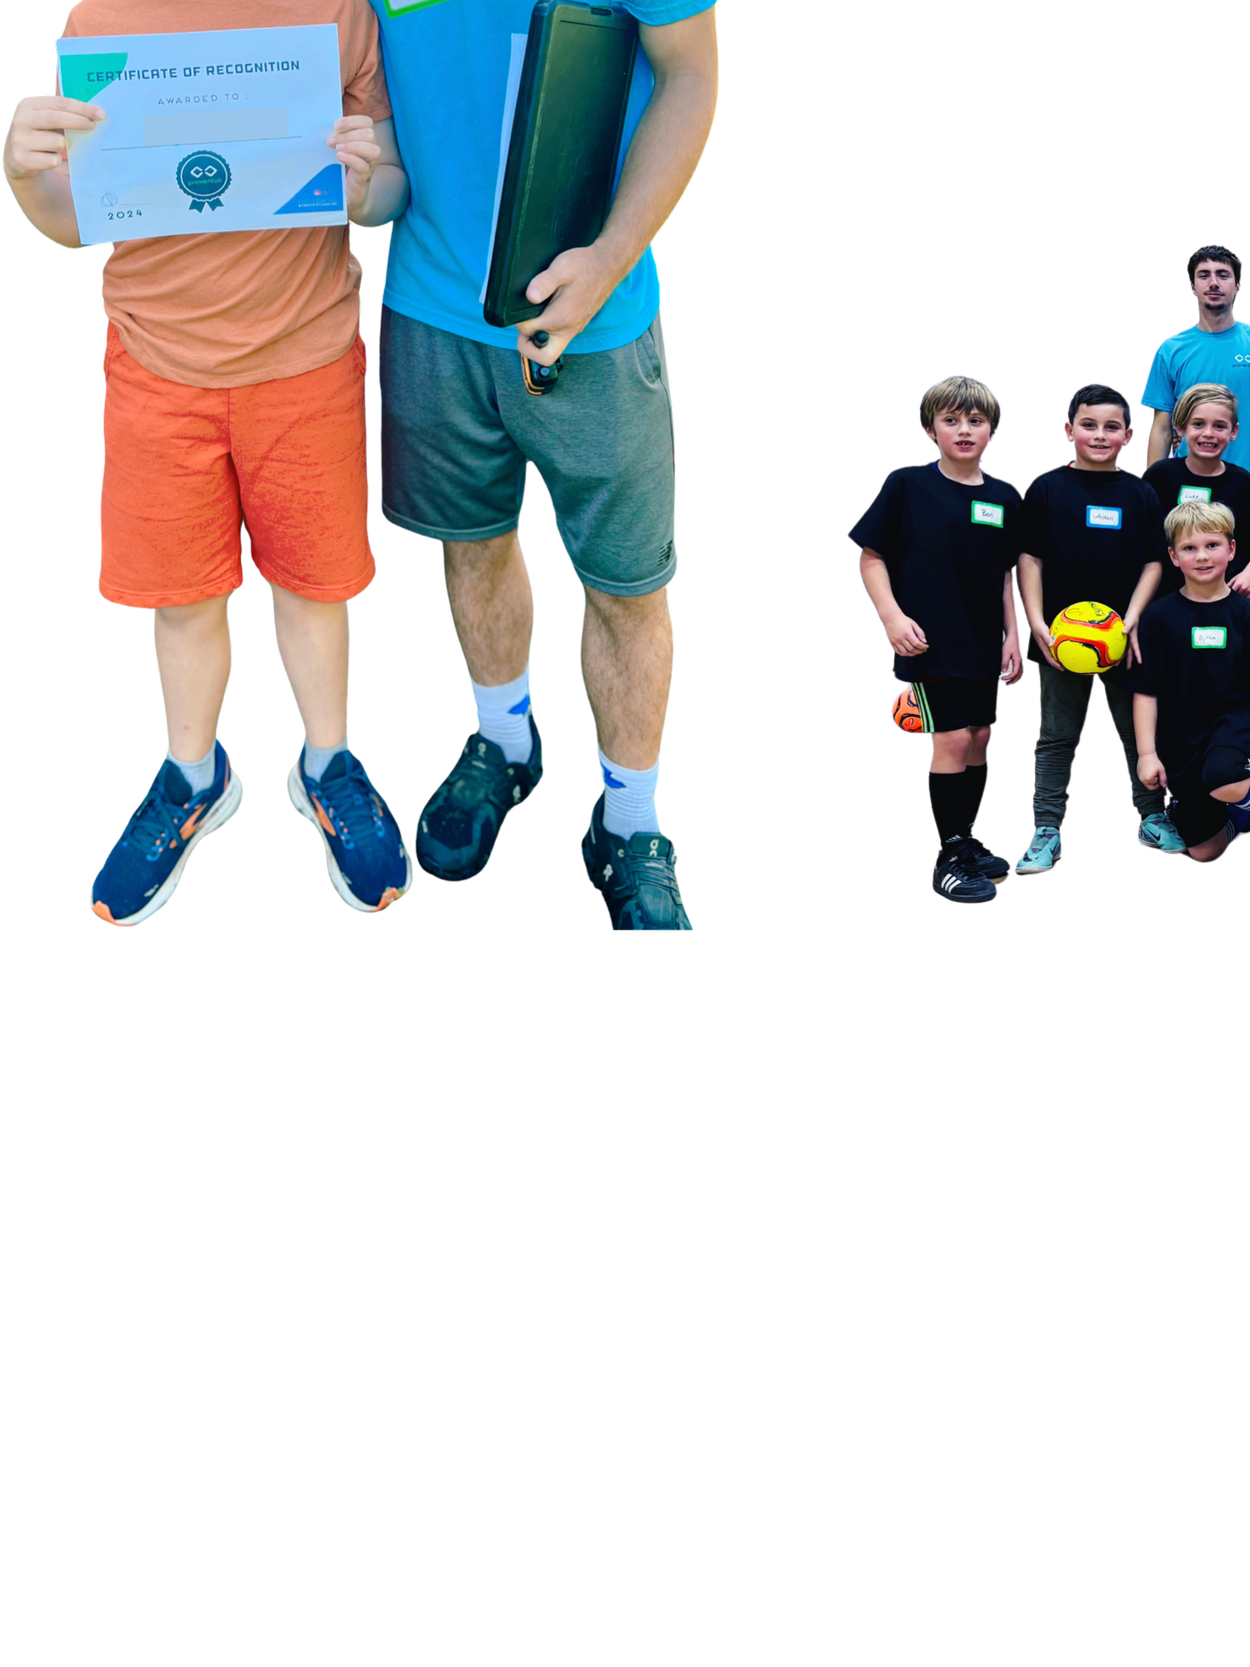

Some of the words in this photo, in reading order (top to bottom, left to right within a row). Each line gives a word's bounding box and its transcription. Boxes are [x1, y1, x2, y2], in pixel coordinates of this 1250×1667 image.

[86, 67, 178, 83] CERTIFICATE
[183, 66, 201, 78] OF
[206, 60, 300, 77] RECOGNITION
[157, 94, 219, 106] AWARDED
[224, 92, 240, 101] TO
[107, 209, 143, 221] 2024
